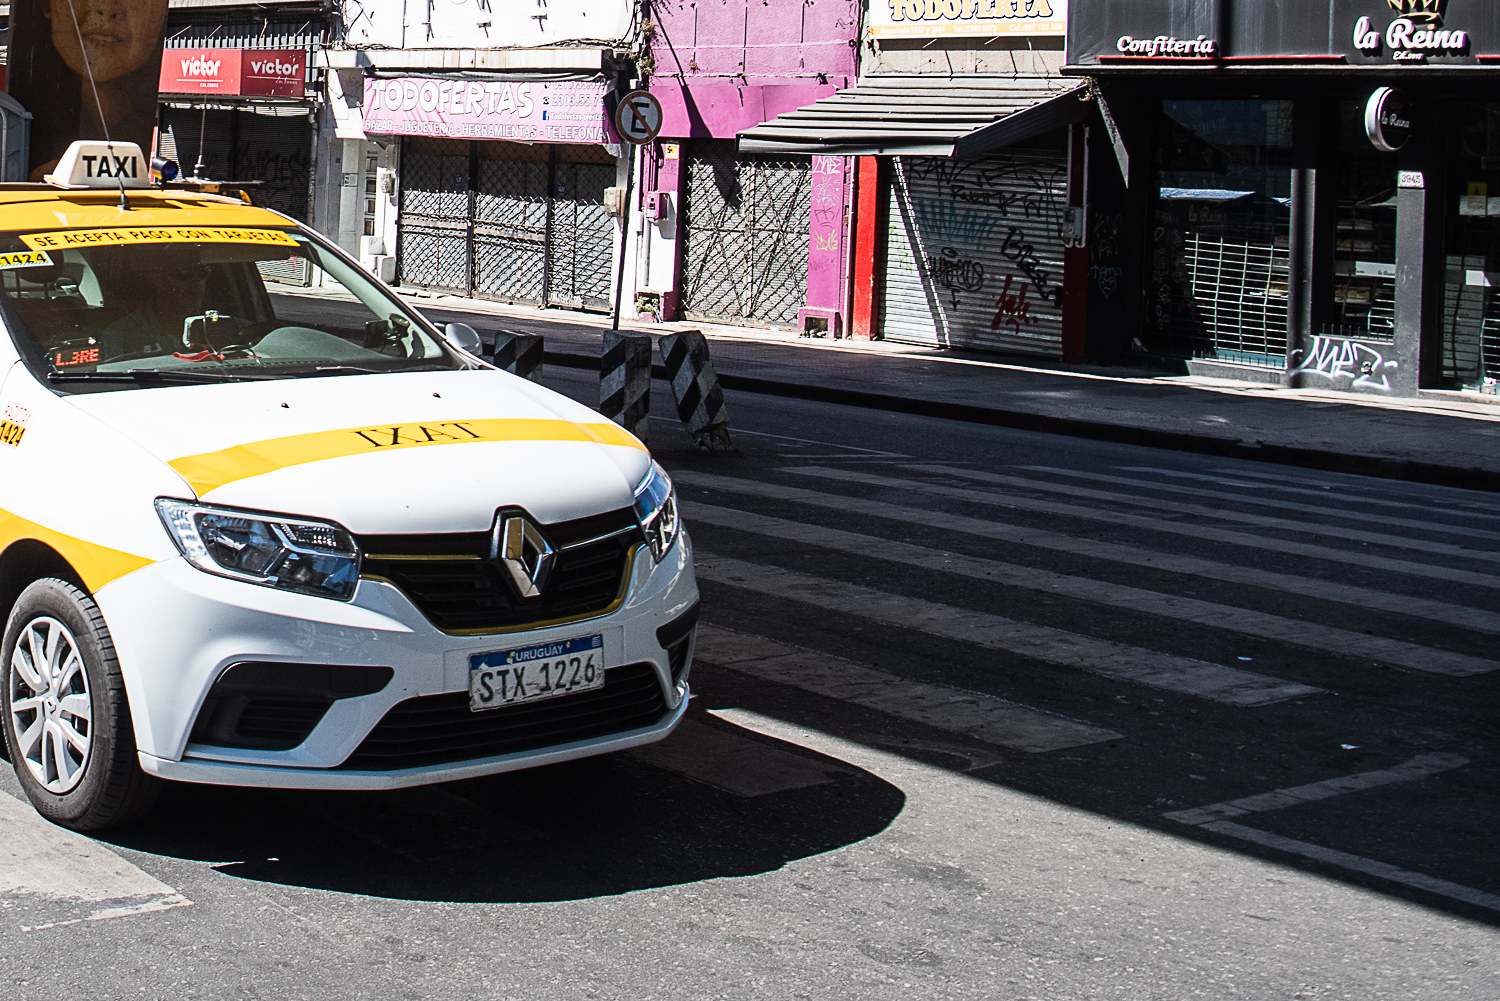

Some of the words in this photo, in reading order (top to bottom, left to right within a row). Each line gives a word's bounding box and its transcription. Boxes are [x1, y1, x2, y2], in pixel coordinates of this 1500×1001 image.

[1386, 18, 1466, 49] Reina
[1116, 34, 1214, 56] Confitería
[371, 80, 534, 118] TODOFERTAS
[365, 120, 393, 131] BAZAR
[462, 124, 537, 138] HERRAMIENTAS
[82, 155, 137, 178] TAXI
[1399, 175, 1421, 184] 3945
[34, 237, 55, 247] SE
[65, 232, 124, 243] ACEPTA
[133, 231, 171, 240] PAGO
[181, 231, 210, 240] CON
[216, 231, 288, 242] TARJETAS
[0, 252, 46, 266] 1424
[55, 348, 100, 367] LRE
[515, 644, 564, 662] URUGUAY
[479, 666, 527, 703] STX
[538, 653, 595, 692] 1226
